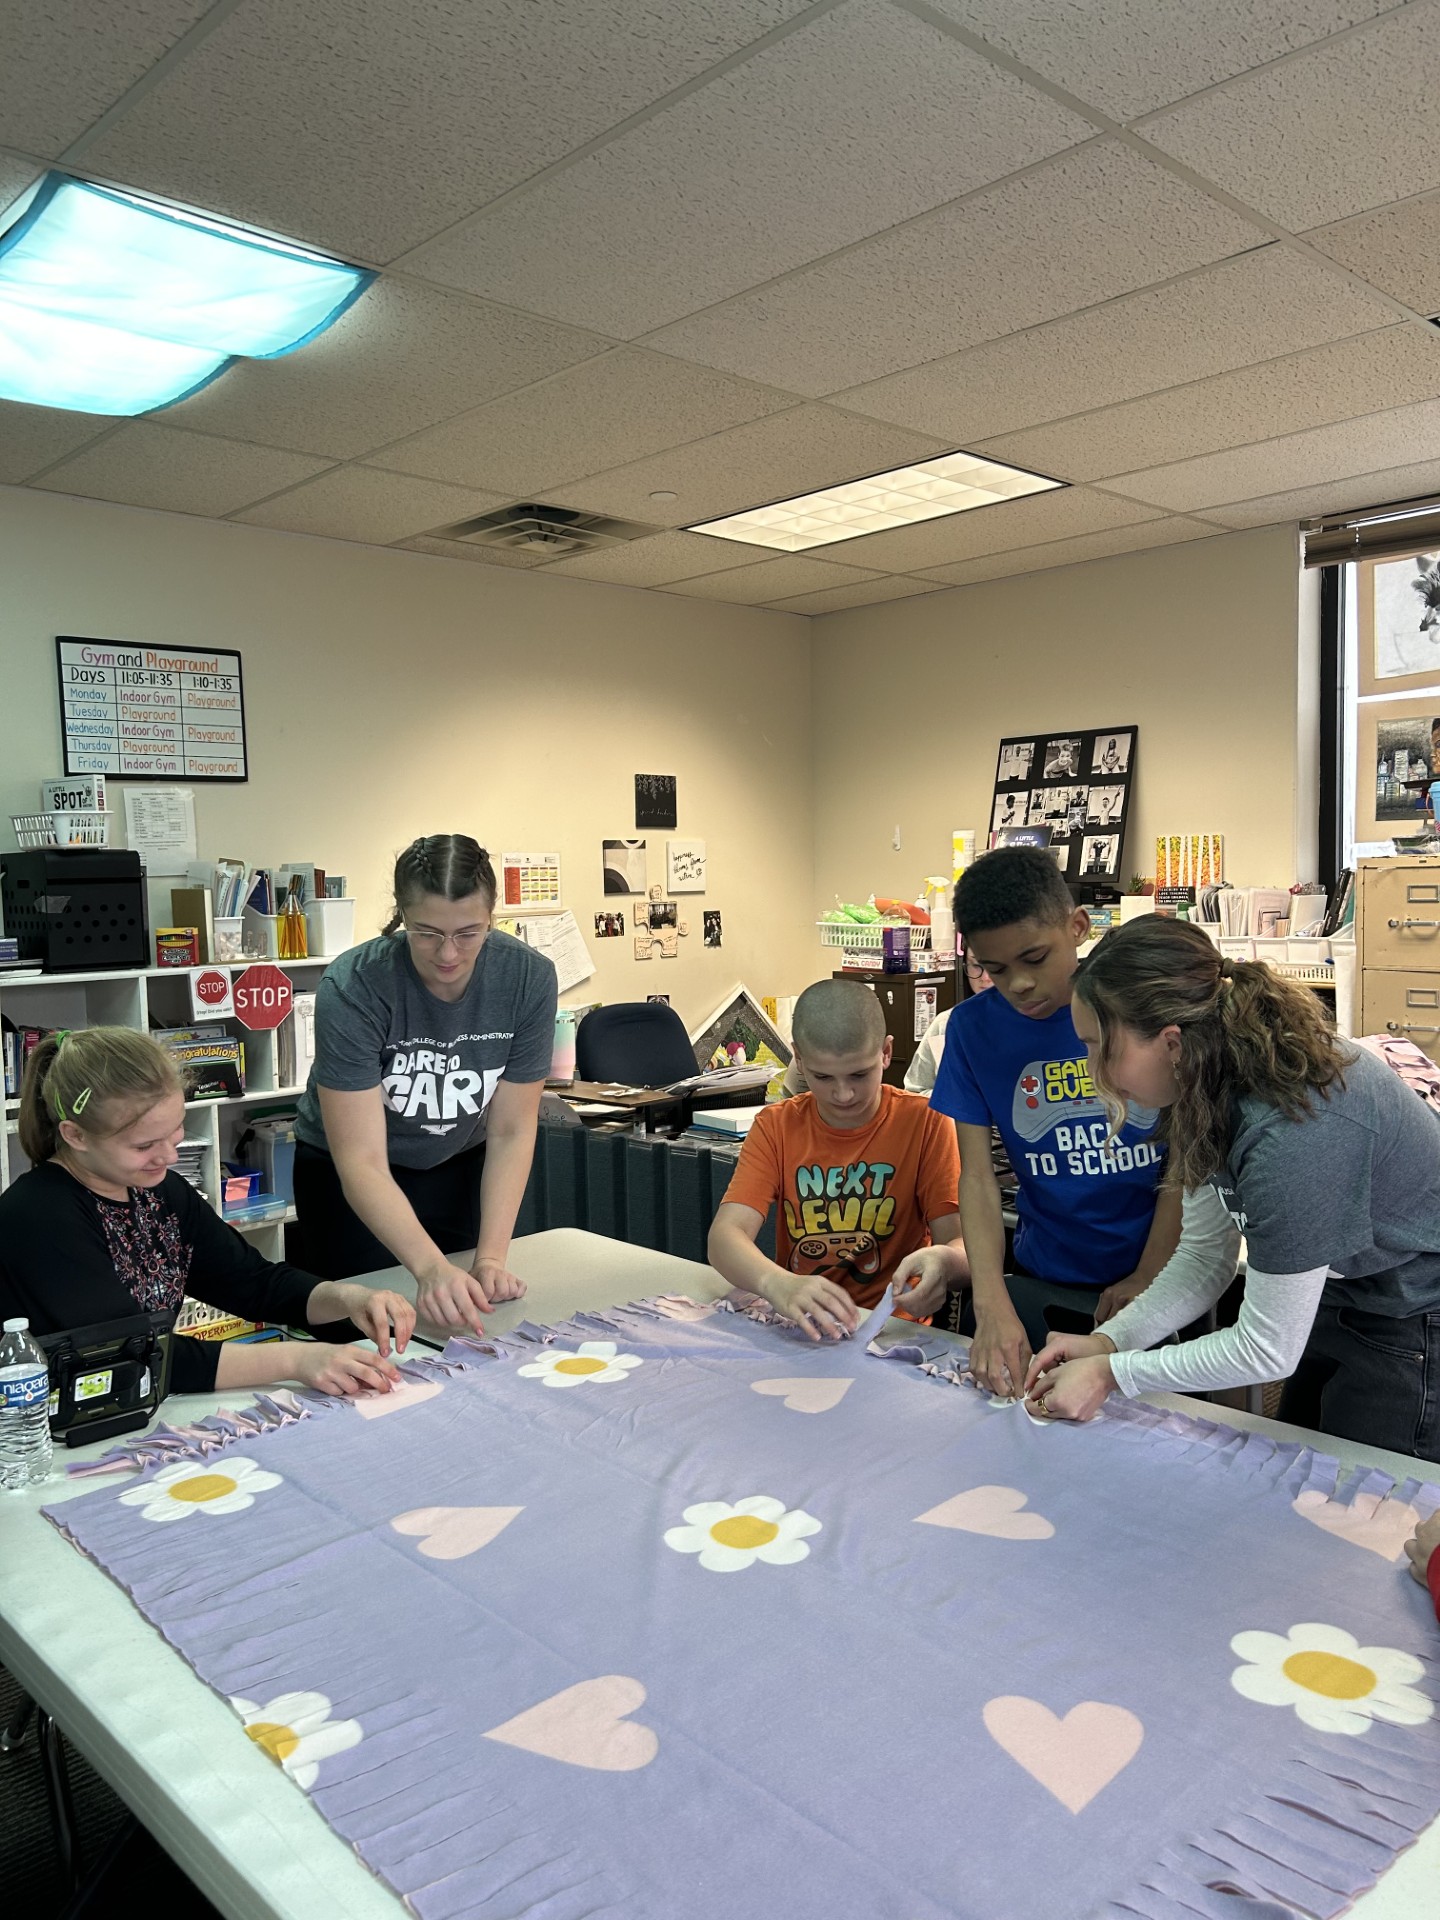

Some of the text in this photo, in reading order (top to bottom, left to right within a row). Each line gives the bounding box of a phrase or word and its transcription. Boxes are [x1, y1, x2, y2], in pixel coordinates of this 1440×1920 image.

[81, 647, 218, 673] Gym and Playground
[71, 667, 106, 684] Days
[121, 671, 173, 686] 11:05-11:35
[193, 676, 232, 690] 1:10-1:35
[70, 687, 107, 701] Monday
[120, 689, 176, 707] Indoor Gym
[188, 693, 236, 708] Playground
[70, 704, 108, 718] Tuesday
[122, 706, 176, 722] Playground
[67, 722, 114, 736] Wednesday
[122, 722, 175, 740] Indoor Gym
[188, 727, 236, 743] Playground
[71, 738, 112, 752] Thursday
[123, 740, 175, 756] Playground
[78, 756, 109, 770] Friday
[124, 757, 177, 774] Indoor Gym
[189, 760, 238, 774] Playground
[54, 791, 83, 810] SPOT
[199, 981, 225, 995] STOP
[236, 986, 290, 1009] STOP
[391, 1049, 447, 1075] DARE
[1045, 1058, 1089, 1081] GAM
[1046, 1076, 1097, 1102] OVE
[1055, 1122, 1124, 1151] BACK
[1025, 1143, 1162, 1176] TO SCHOOL
[796, 1161, 896, 1198] NEXT
[193, 1321, 242, 1340] OPERATION
[3, 1374, 48, 1397] niagara
